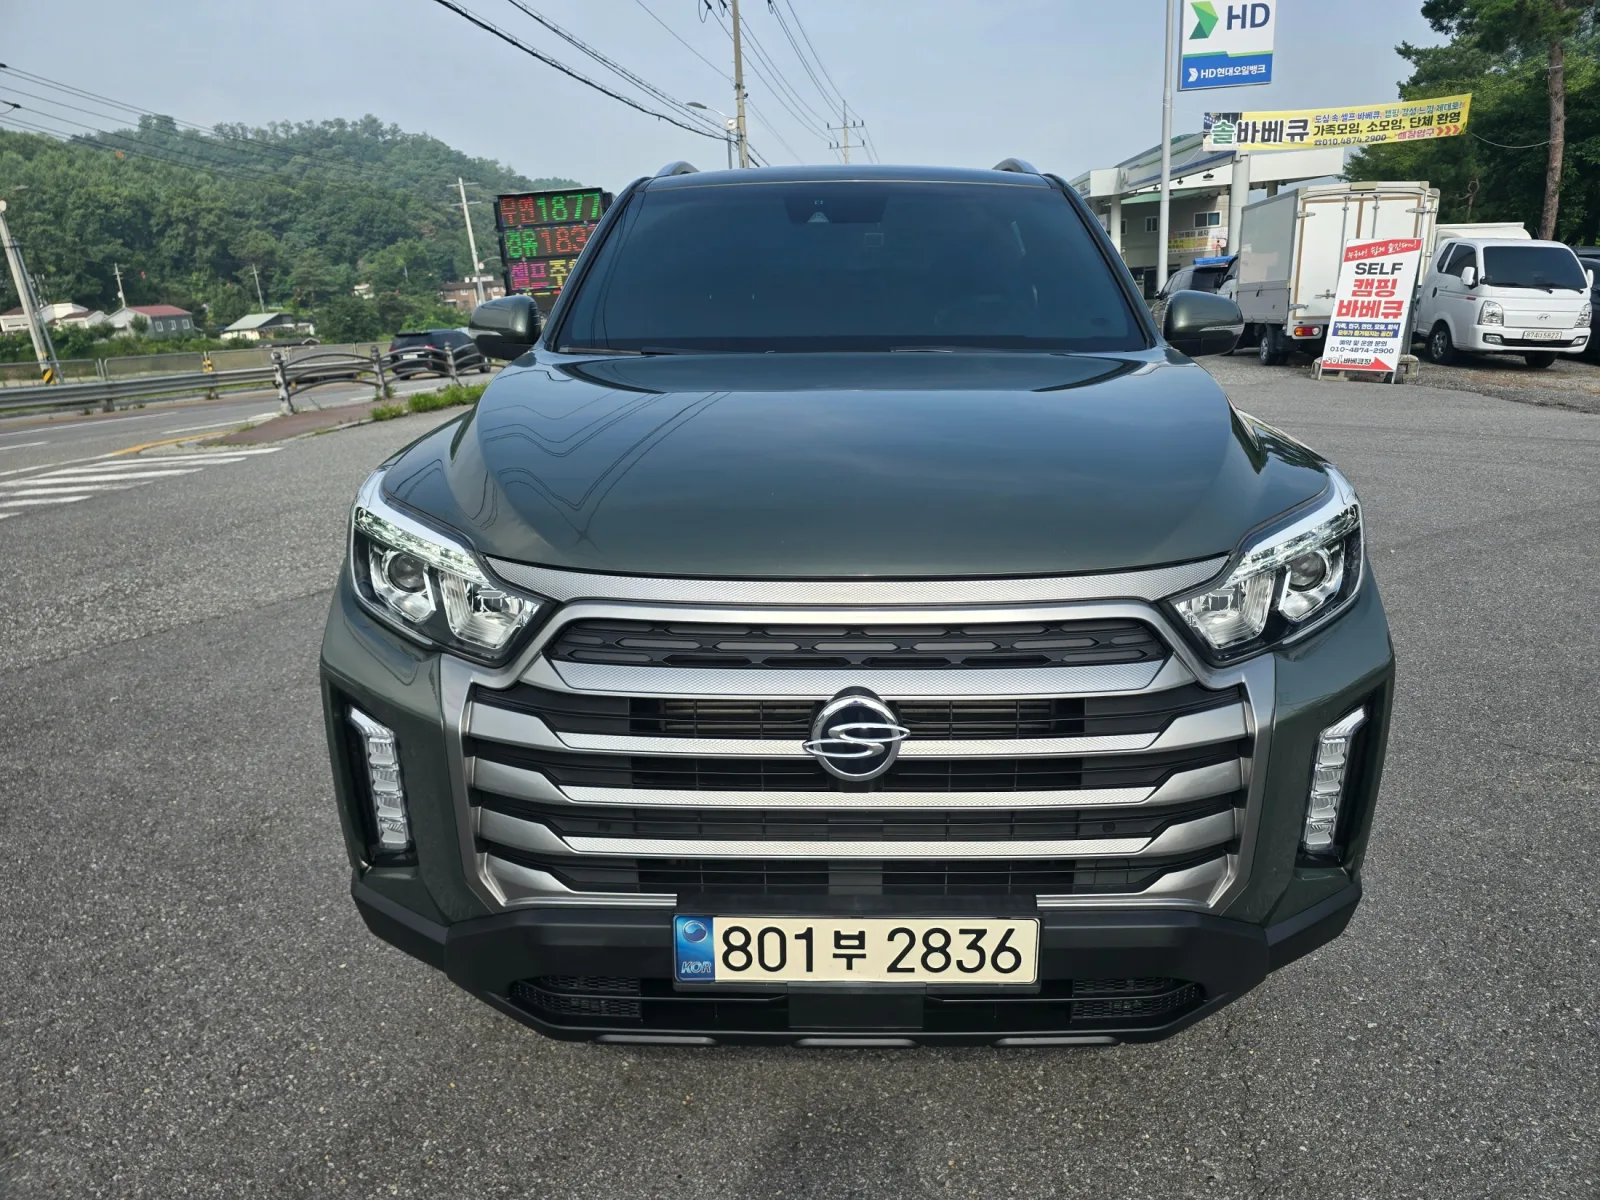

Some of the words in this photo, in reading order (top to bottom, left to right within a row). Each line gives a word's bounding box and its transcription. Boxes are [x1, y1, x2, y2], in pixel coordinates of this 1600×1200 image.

[1226, 3, 1270, 30] HD
[1200, 64, 1266, 79] HD현대오일뱅크
[1313, 122, 1363, 136] 가족모임,
[1366, 119, 1405, 132] 소모임,
[1409, 115, 1434, 128] 단체
[1436, 111, 1461, 125] 환영
[1314, 114, 1330, 123] 도심
[1341, 112, 1355, 122] 셀프
[1385, 109, 1400, 118] 캠핑
[536, 193, 600, 221] 1877
[506, 229, 538, 258] 경유
[541, 226, 597, 253] 183
[510, 262, 549, 288] 셀프
[549, 259, 577, 286] 주
[1354, 262, 1403, 275] SELF
[1351, 278, 1398, 298] 캠핑
[1336, 300, 1404, 319] 바베큐
[1329, 346, 1395, 354] 010-4874-2900
[721, 926, 867, 973] 801부
[886, 927, 1022, 974] 2836
[681, 961, 712, 974] KOR
